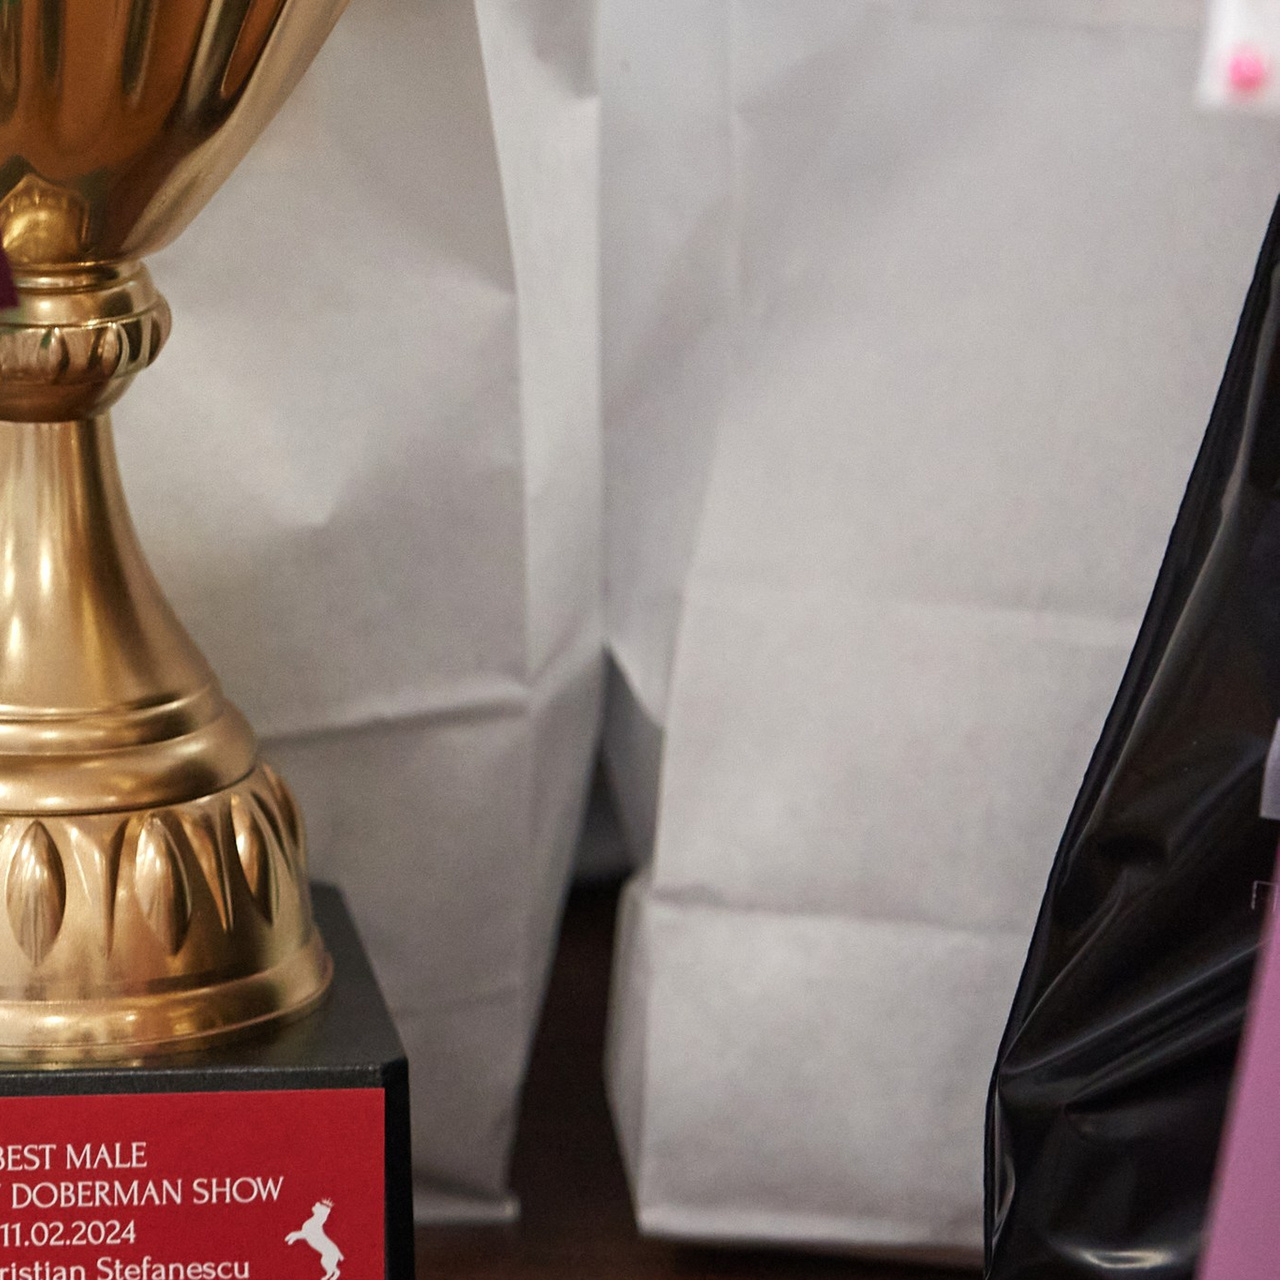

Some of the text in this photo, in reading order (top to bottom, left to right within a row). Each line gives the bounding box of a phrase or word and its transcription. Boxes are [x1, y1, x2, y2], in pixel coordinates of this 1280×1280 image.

[65, 1141, 148, 1170] MALE
[11, 1178, 183, 1209] DOBERMAN
[192, 1175, 285, 1205] SHOW
[96, 1255, 250, 1280] Stefanescu
